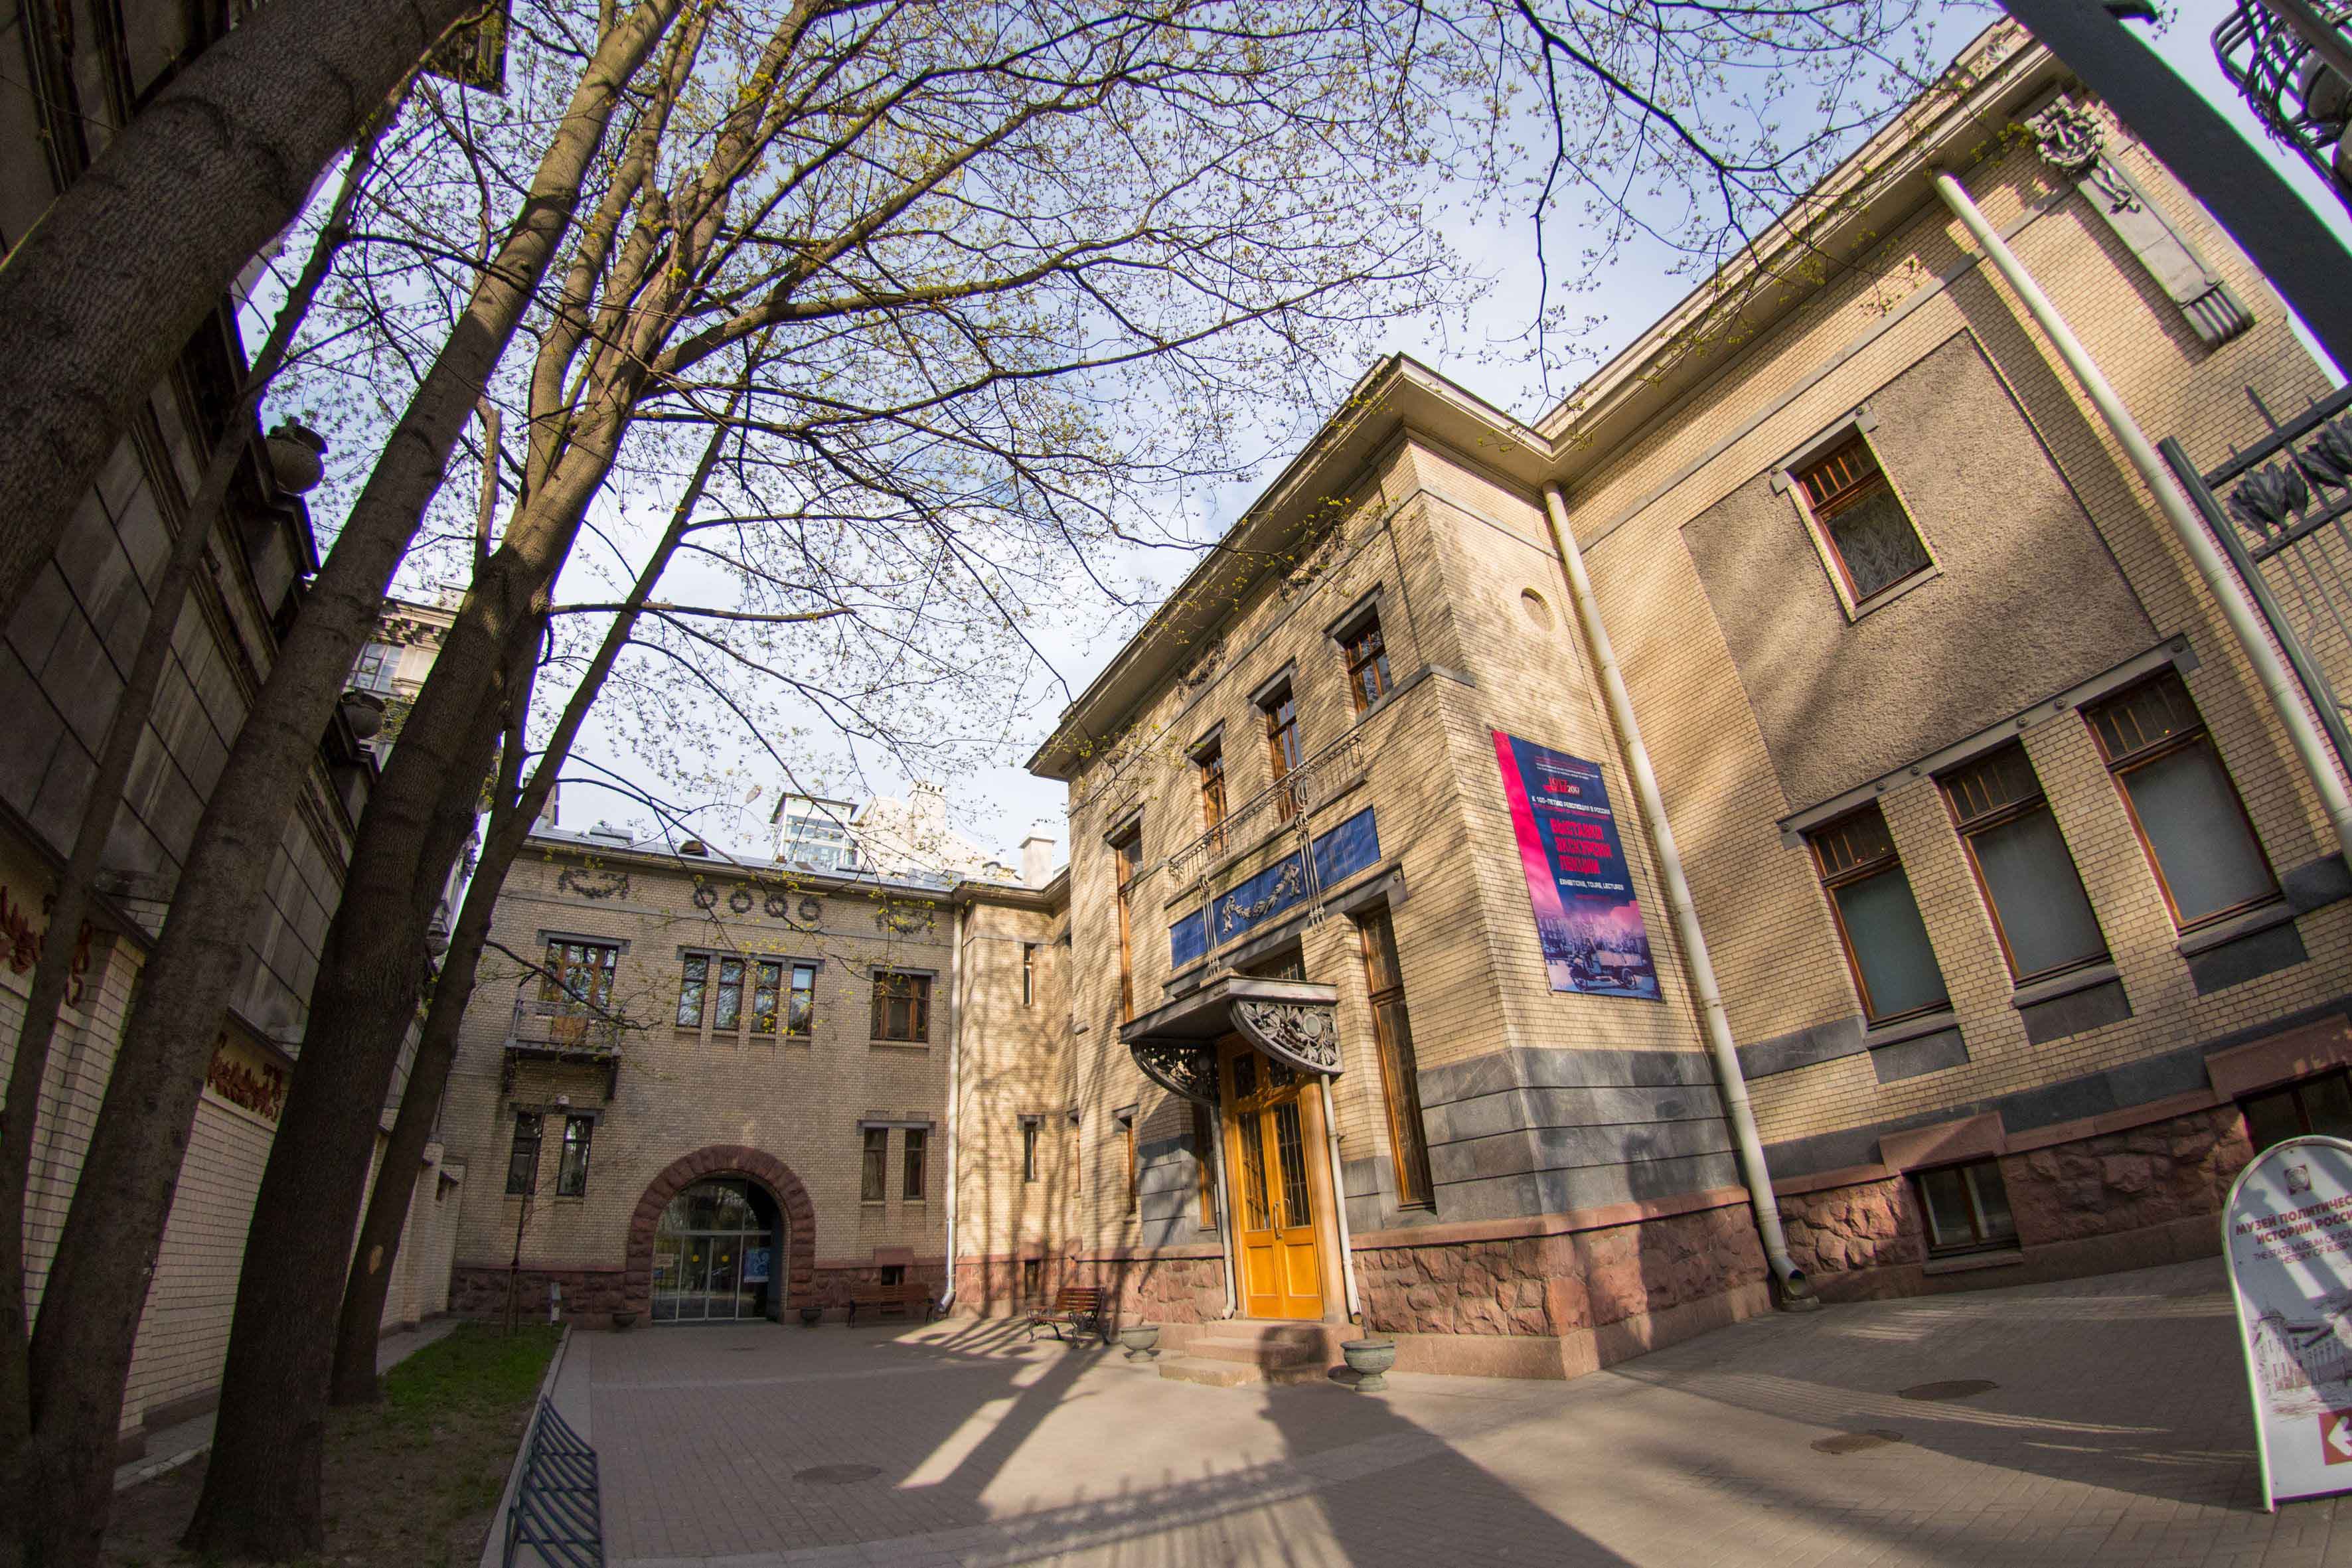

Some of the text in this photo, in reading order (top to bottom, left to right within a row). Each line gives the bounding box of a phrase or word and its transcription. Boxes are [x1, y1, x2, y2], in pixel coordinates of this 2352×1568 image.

[1567, 785, 1580, 795] 2017
[2235, 1214, 2277, 1236] МУЗЕЙ
[2255, 1221, 2313, 1243] ИСТОРИИ
